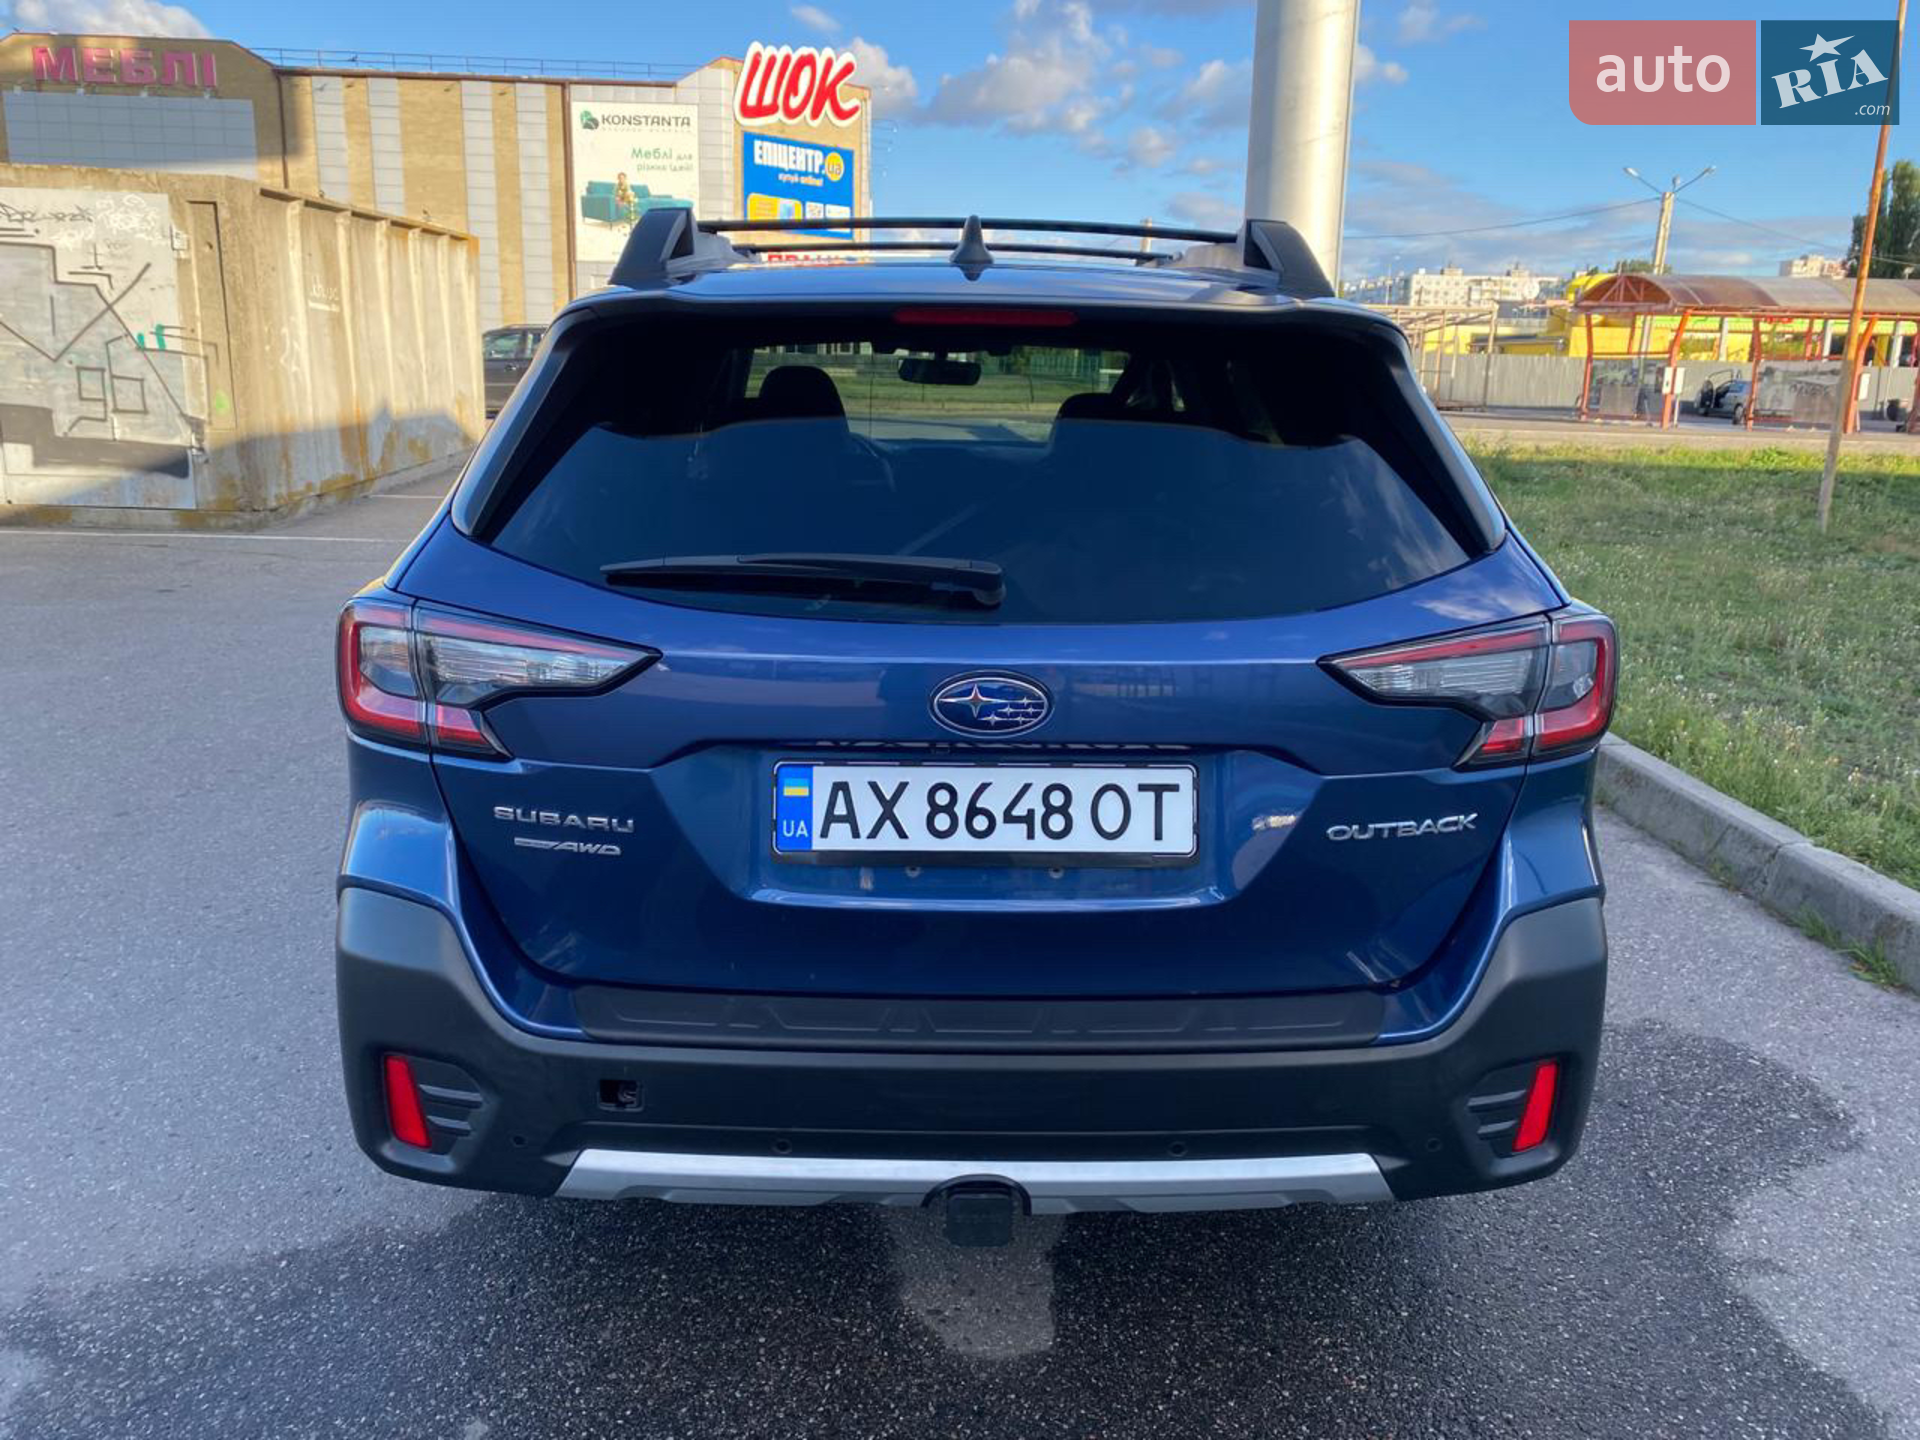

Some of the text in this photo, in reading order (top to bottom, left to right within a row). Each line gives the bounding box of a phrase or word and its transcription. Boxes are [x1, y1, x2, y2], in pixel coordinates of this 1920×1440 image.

[32, 46, 218, 88] МЕБЛІ
[738, 49, 862, 123] ШОК
[601, 114, 691, 127] KONSTANTA
[493, 805, 635, 834] SUBARU
[819, 780, 1181, 842] AX 8648 OT
[782, 820, 809, 838] UA
[1325, 812, 1479, 841] OUTBACK
[553, 840, 622, 856] AWD
